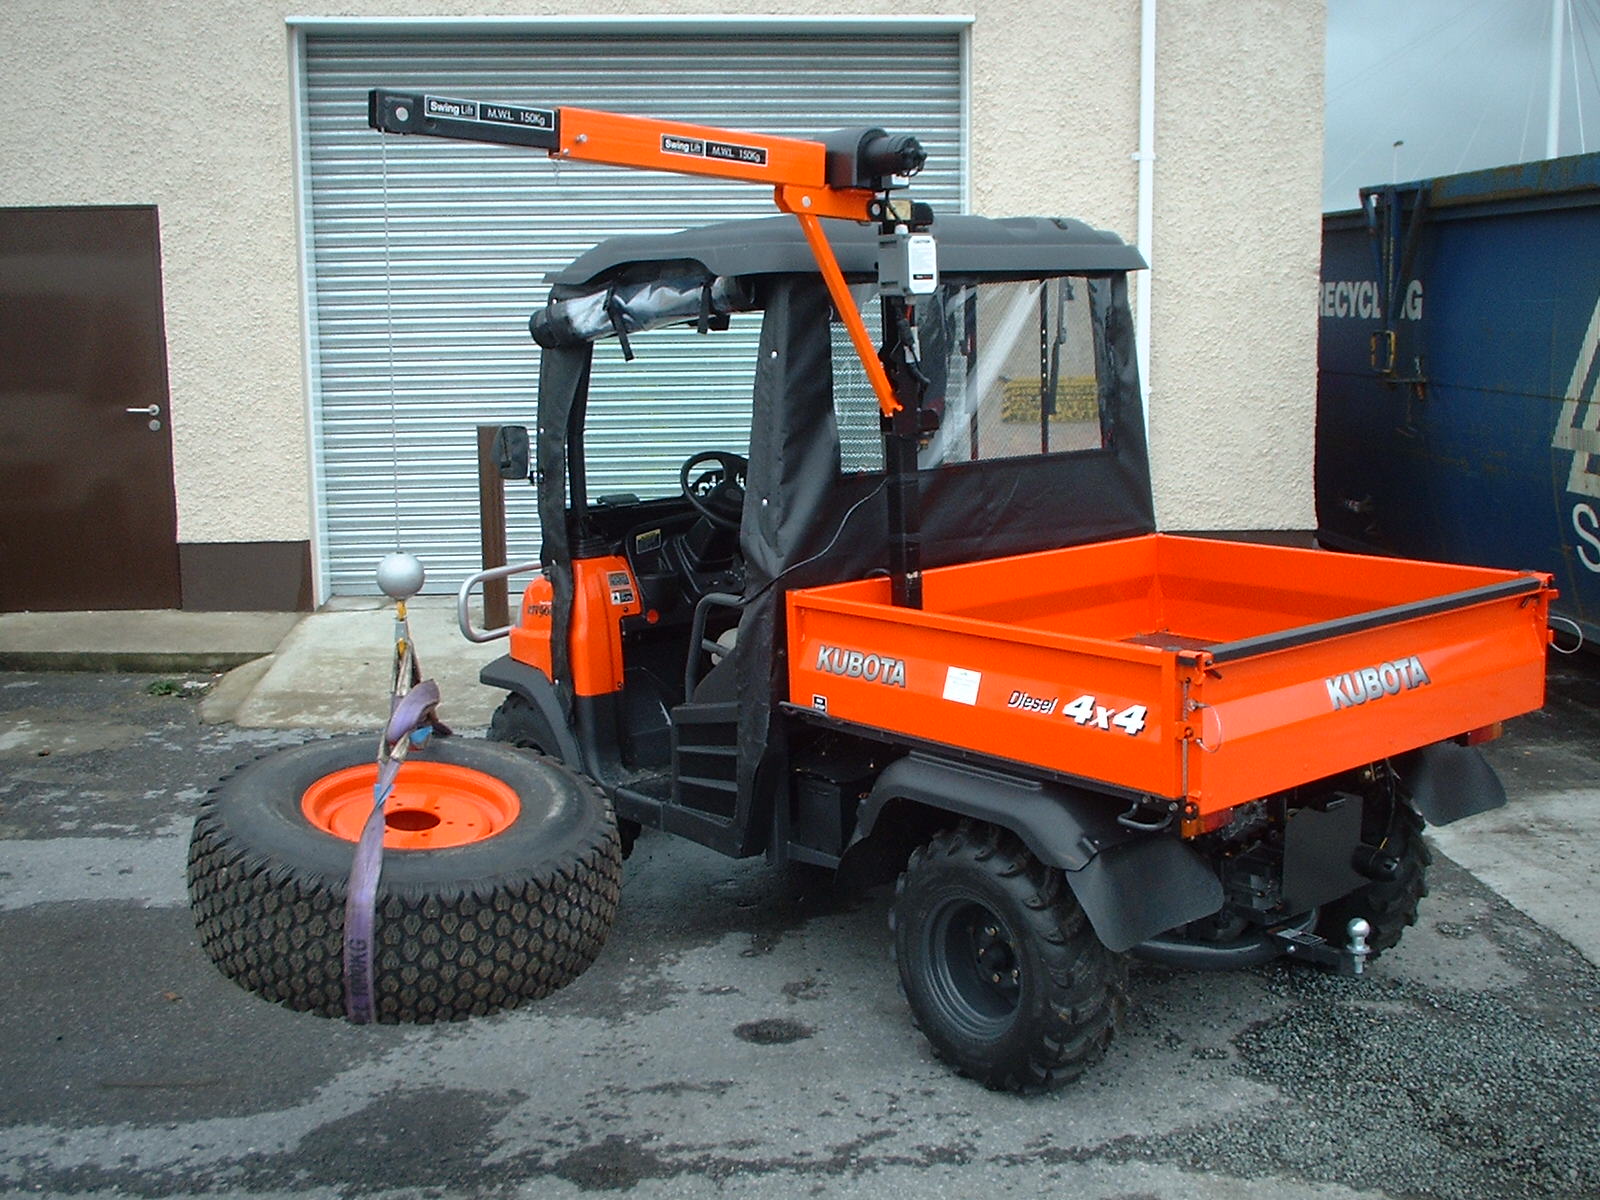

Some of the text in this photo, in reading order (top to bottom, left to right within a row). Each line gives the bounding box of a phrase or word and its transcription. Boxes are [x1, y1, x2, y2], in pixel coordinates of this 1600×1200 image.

[430, 101, 474, 116] Swing Lift
[520, 111, 546, 127] 150Kg
[665, 138, 701, 153] Swing Lift
[1318, 279, 1423, 321] ECYCLG
[815, 644, 906, 688] KUBOTA
[1325, 654, 1432, 711] KUBOTA
[1008, 690, 1148, 736] Diesel 4x4
